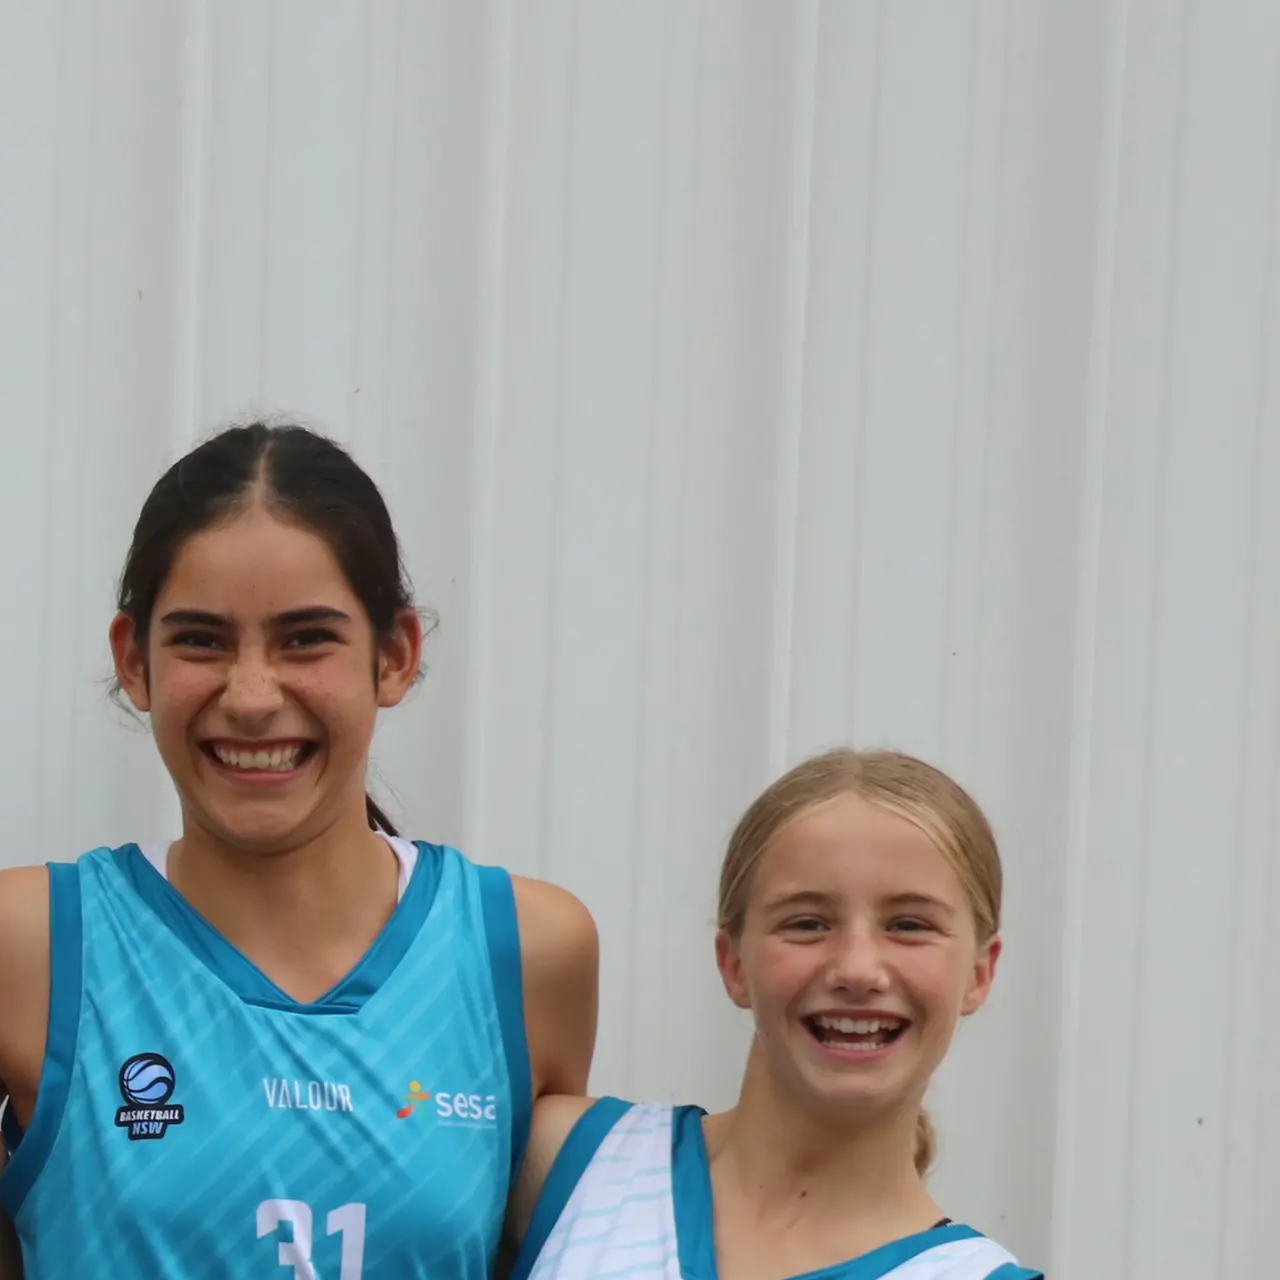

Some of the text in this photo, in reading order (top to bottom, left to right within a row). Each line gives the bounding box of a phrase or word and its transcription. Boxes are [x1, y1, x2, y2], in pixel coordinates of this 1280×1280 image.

[263, 1077, 355, 1113] VALOUR
[119, 1108, 181, 1123] BASKETBALL
[131, 1121, 164, 1136] NSW
